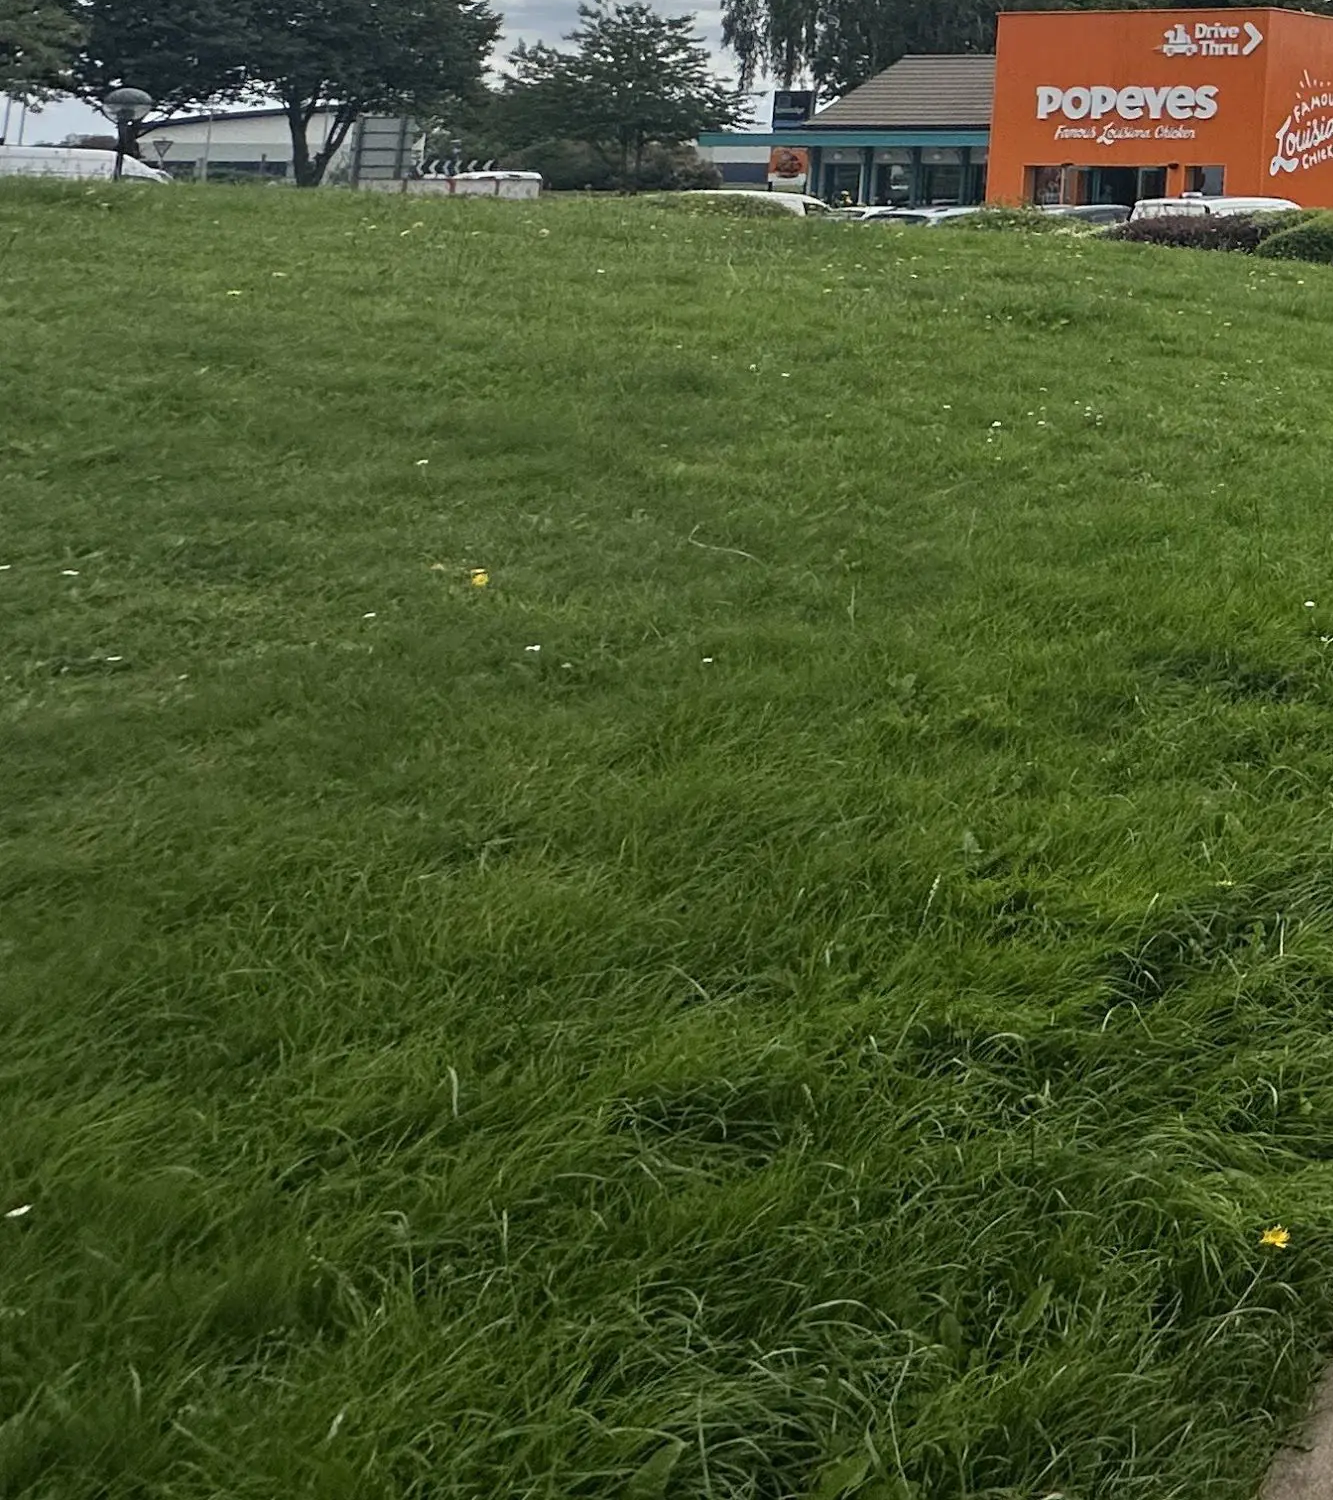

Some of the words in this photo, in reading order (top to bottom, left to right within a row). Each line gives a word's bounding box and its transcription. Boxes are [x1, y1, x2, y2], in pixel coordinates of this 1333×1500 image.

[1195, 22, 1239, 38] Drive
[1199, 40, 1239, 56] Thru
[1054, 124, 1097, 141] Famous
[1096, 121, 1151, 146] Louisiana
[1154, 124, 1196, 140] Chicken
